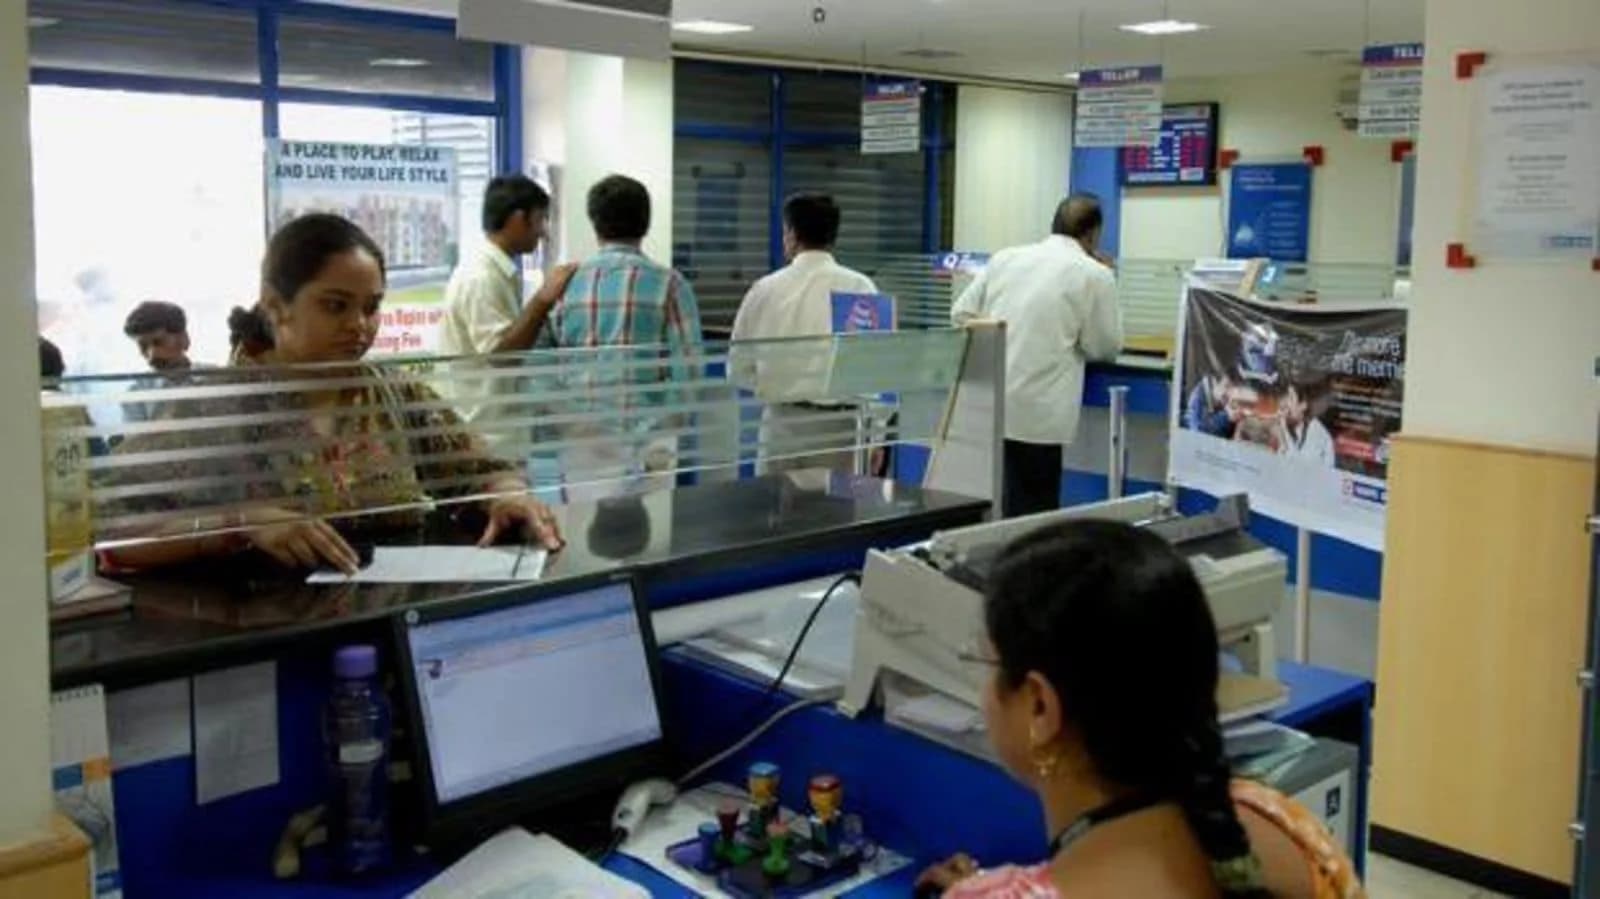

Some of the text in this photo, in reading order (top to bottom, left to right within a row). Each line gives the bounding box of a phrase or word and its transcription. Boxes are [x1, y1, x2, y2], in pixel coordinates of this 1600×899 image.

[1393, 46, 1423, 58] TELL
[281, 143, 290, 158] A
[293, 143, 337, 158] PLACE
[342, 144, 359, 159] TO
[398, 147, 439, 162] RELAX
[275, 163, 448, 183] AND LIVE YOUR LIFE STYLE
